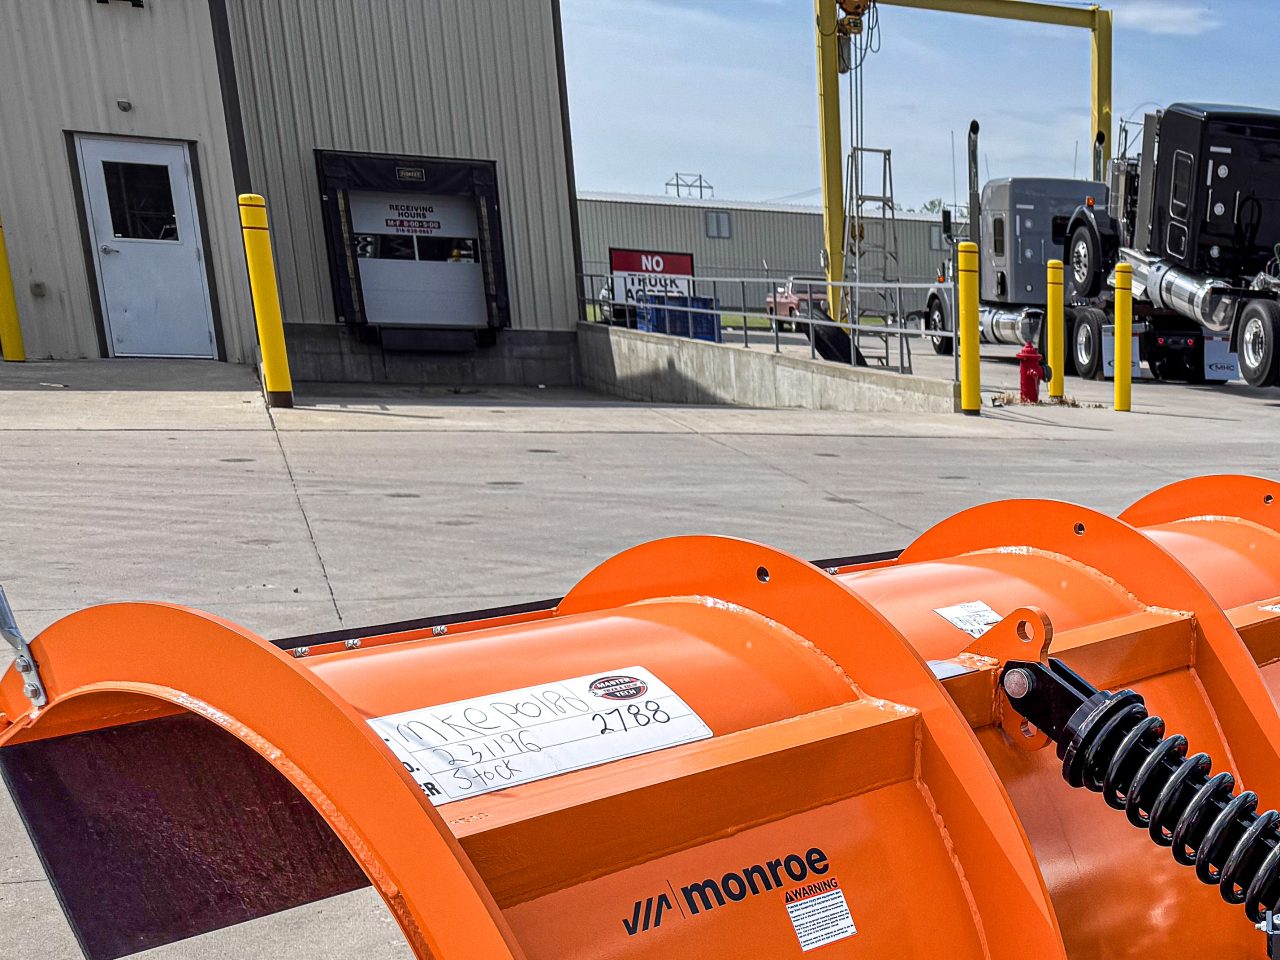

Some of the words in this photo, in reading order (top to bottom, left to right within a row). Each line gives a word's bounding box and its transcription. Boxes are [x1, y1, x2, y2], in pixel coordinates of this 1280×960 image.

[389, 204, 434, 213] RECEIVING
[398, 211, 427, 219] HOURS
[641, 254, 664, 272] NO
[628, 273, 679, 288] TRUCK
[596, 677, 632, 689] MASTER
[616, 688, 637, 698] TECH
[592, 700, 671, 736] 2788
[680, 847, 830, 915] monroe
[790, 877, 839, 900] WARNING
